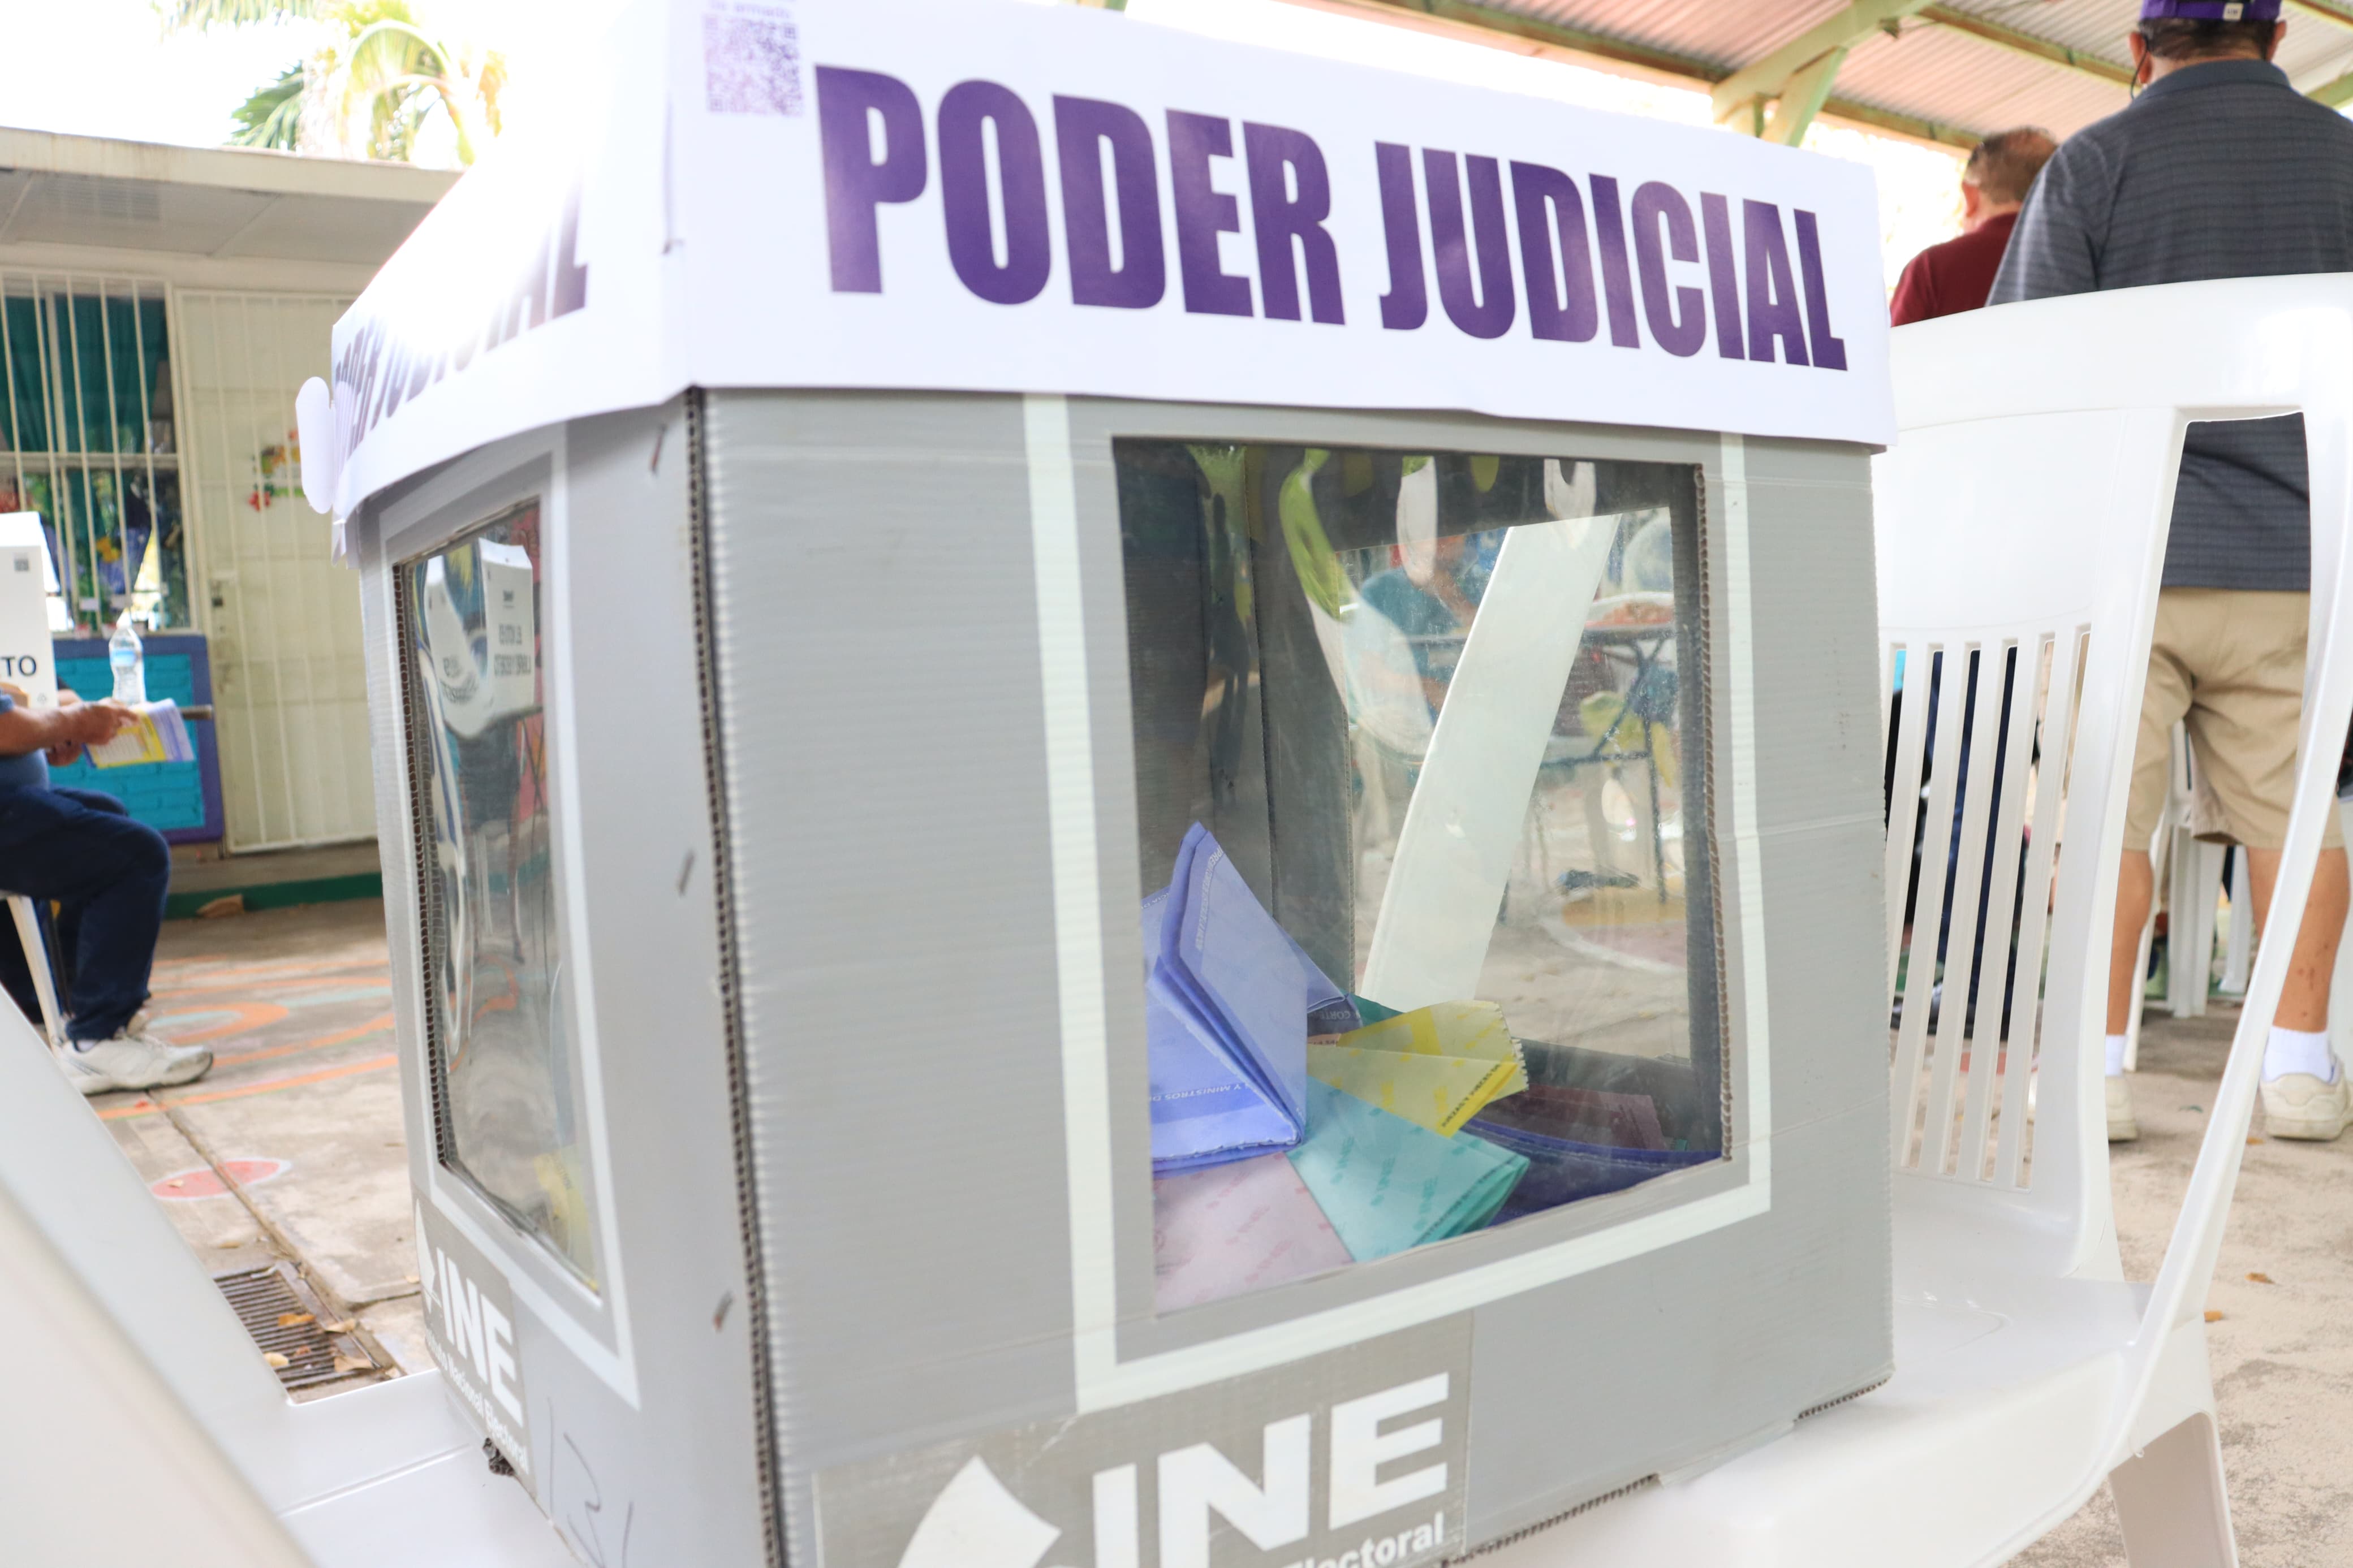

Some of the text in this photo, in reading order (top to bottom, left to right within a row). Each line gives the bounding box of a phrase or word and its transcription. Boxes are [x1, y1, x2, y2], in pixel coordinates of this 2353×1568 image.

[815, 64, 1848, 372] PODER JUDICIAL
[1165, 1085, 1231, 1100] MINISTROS
[436, 1247, 524, 1428] INE
[1092, 1372, 1449, 1567] INE
